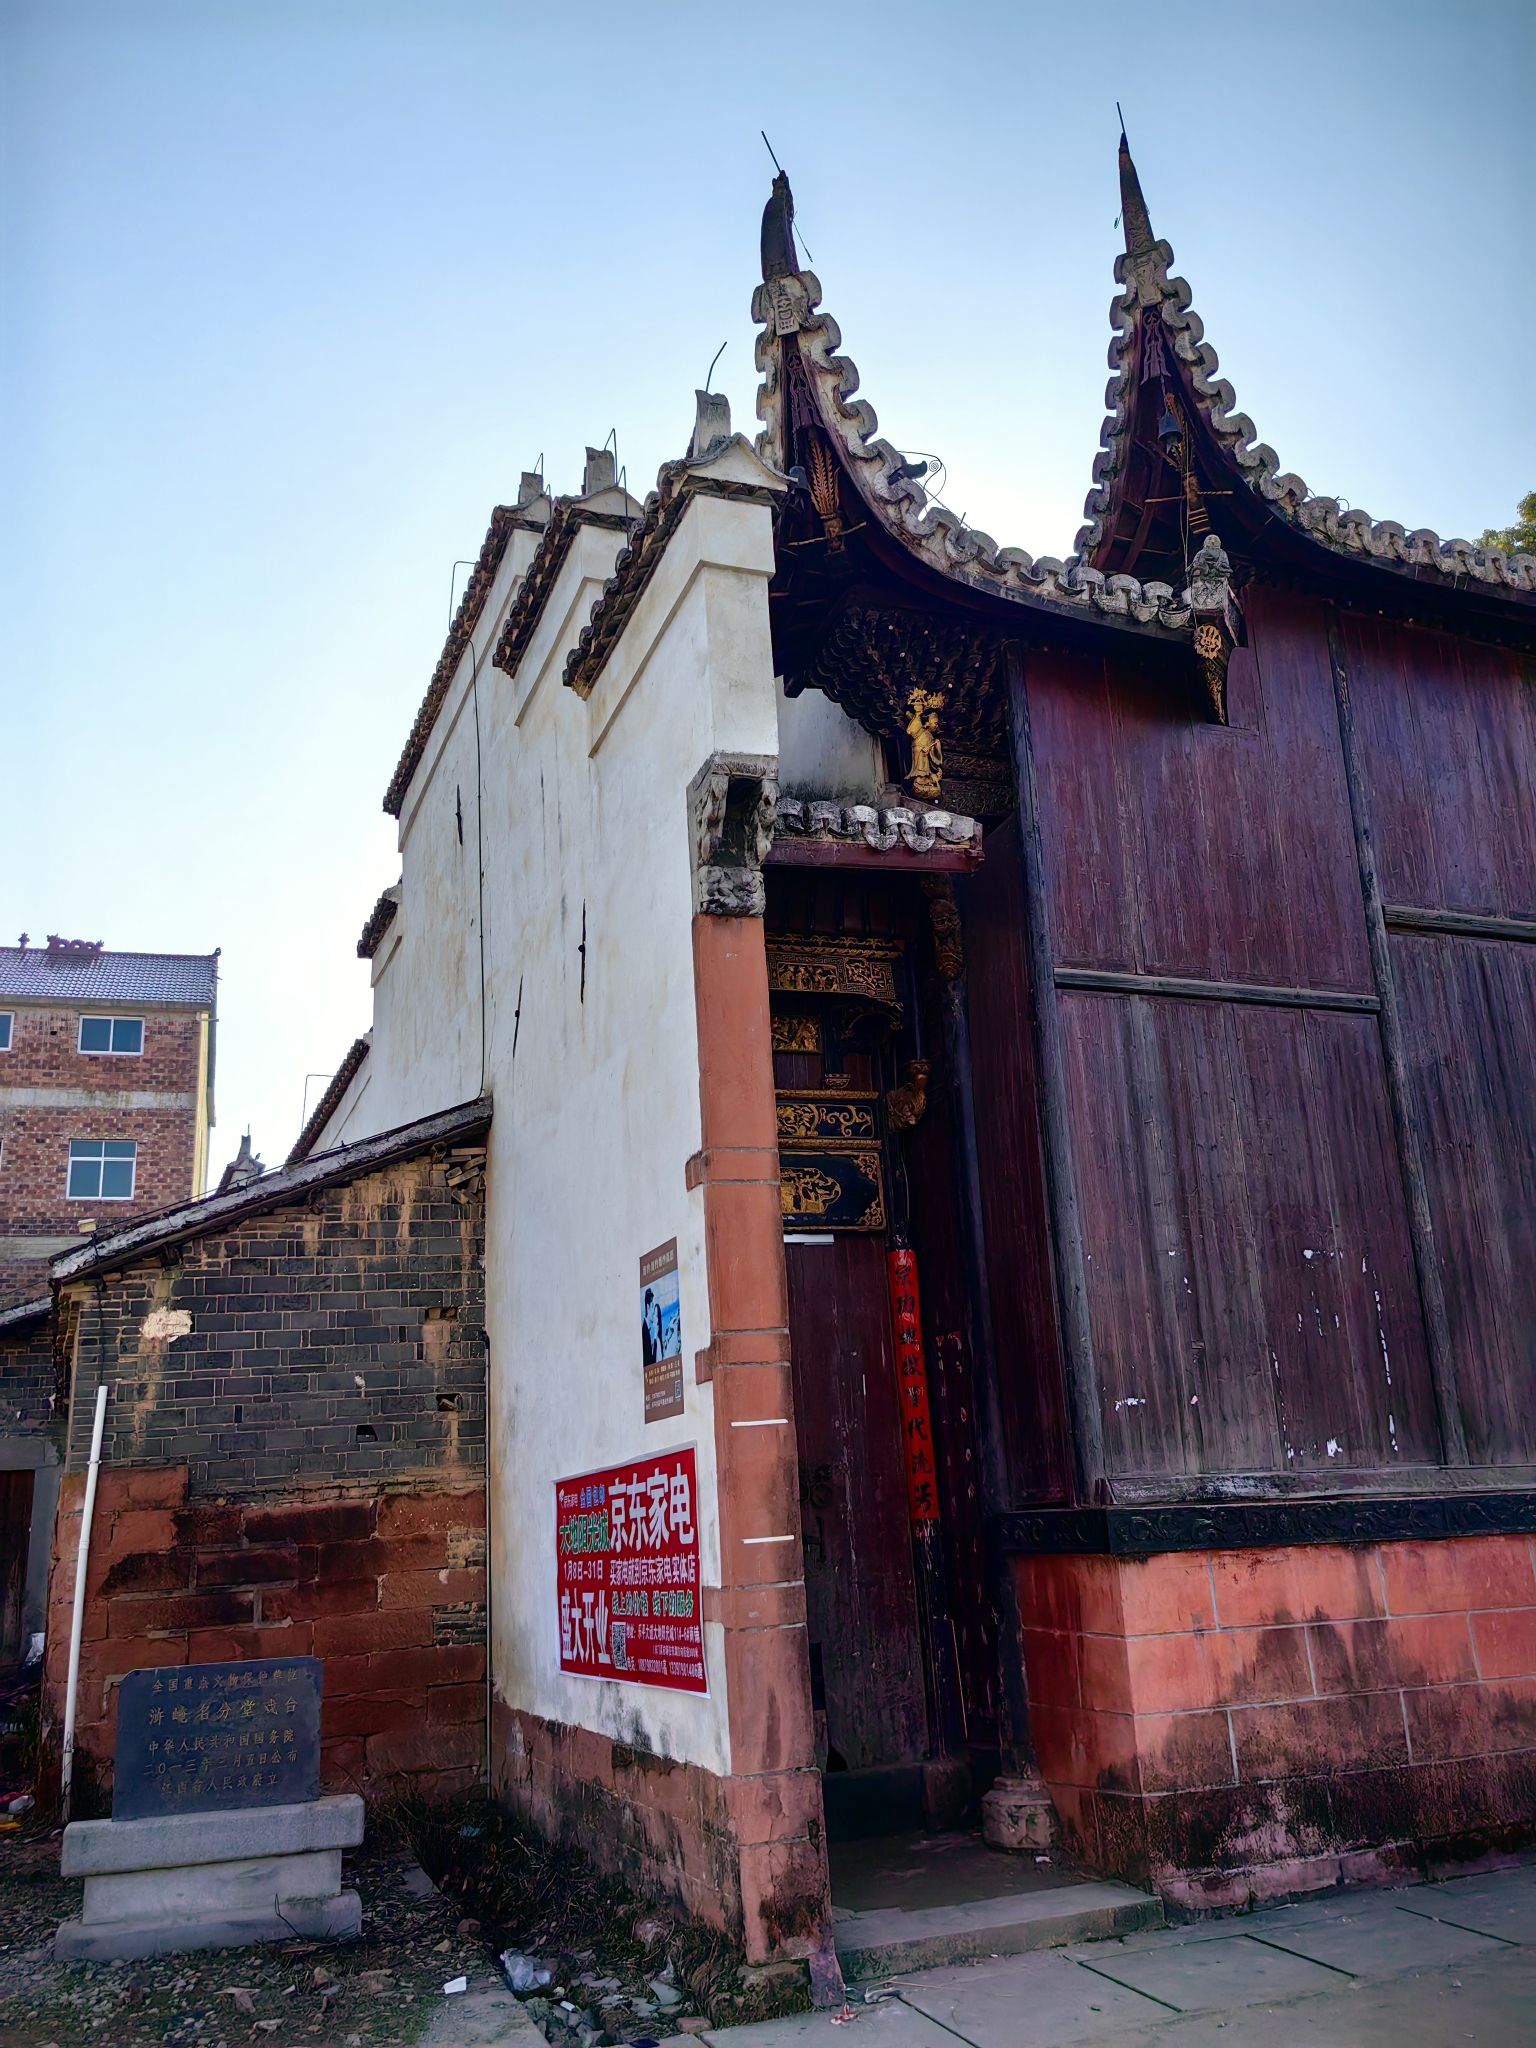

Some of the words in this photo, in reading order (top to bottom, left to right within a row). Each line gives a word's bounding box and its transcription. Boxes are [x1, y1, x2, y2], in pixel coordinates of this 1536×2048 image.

[608, 1463, 695, 1554] 京东家电
[559, 1509, 610, 1555] 大地阳光城
[609, 1552, 696, 1587] 买家电就到京东家电实体店
[652, 1590, 694, 1618] 线下的服务
[561, 1588, 612, 1665] 盛大开业
[152, 1667, 299, 1694] 全国重点文物保护单位
[149, 1728, 296, 1758] 中华人民共和国国务院
